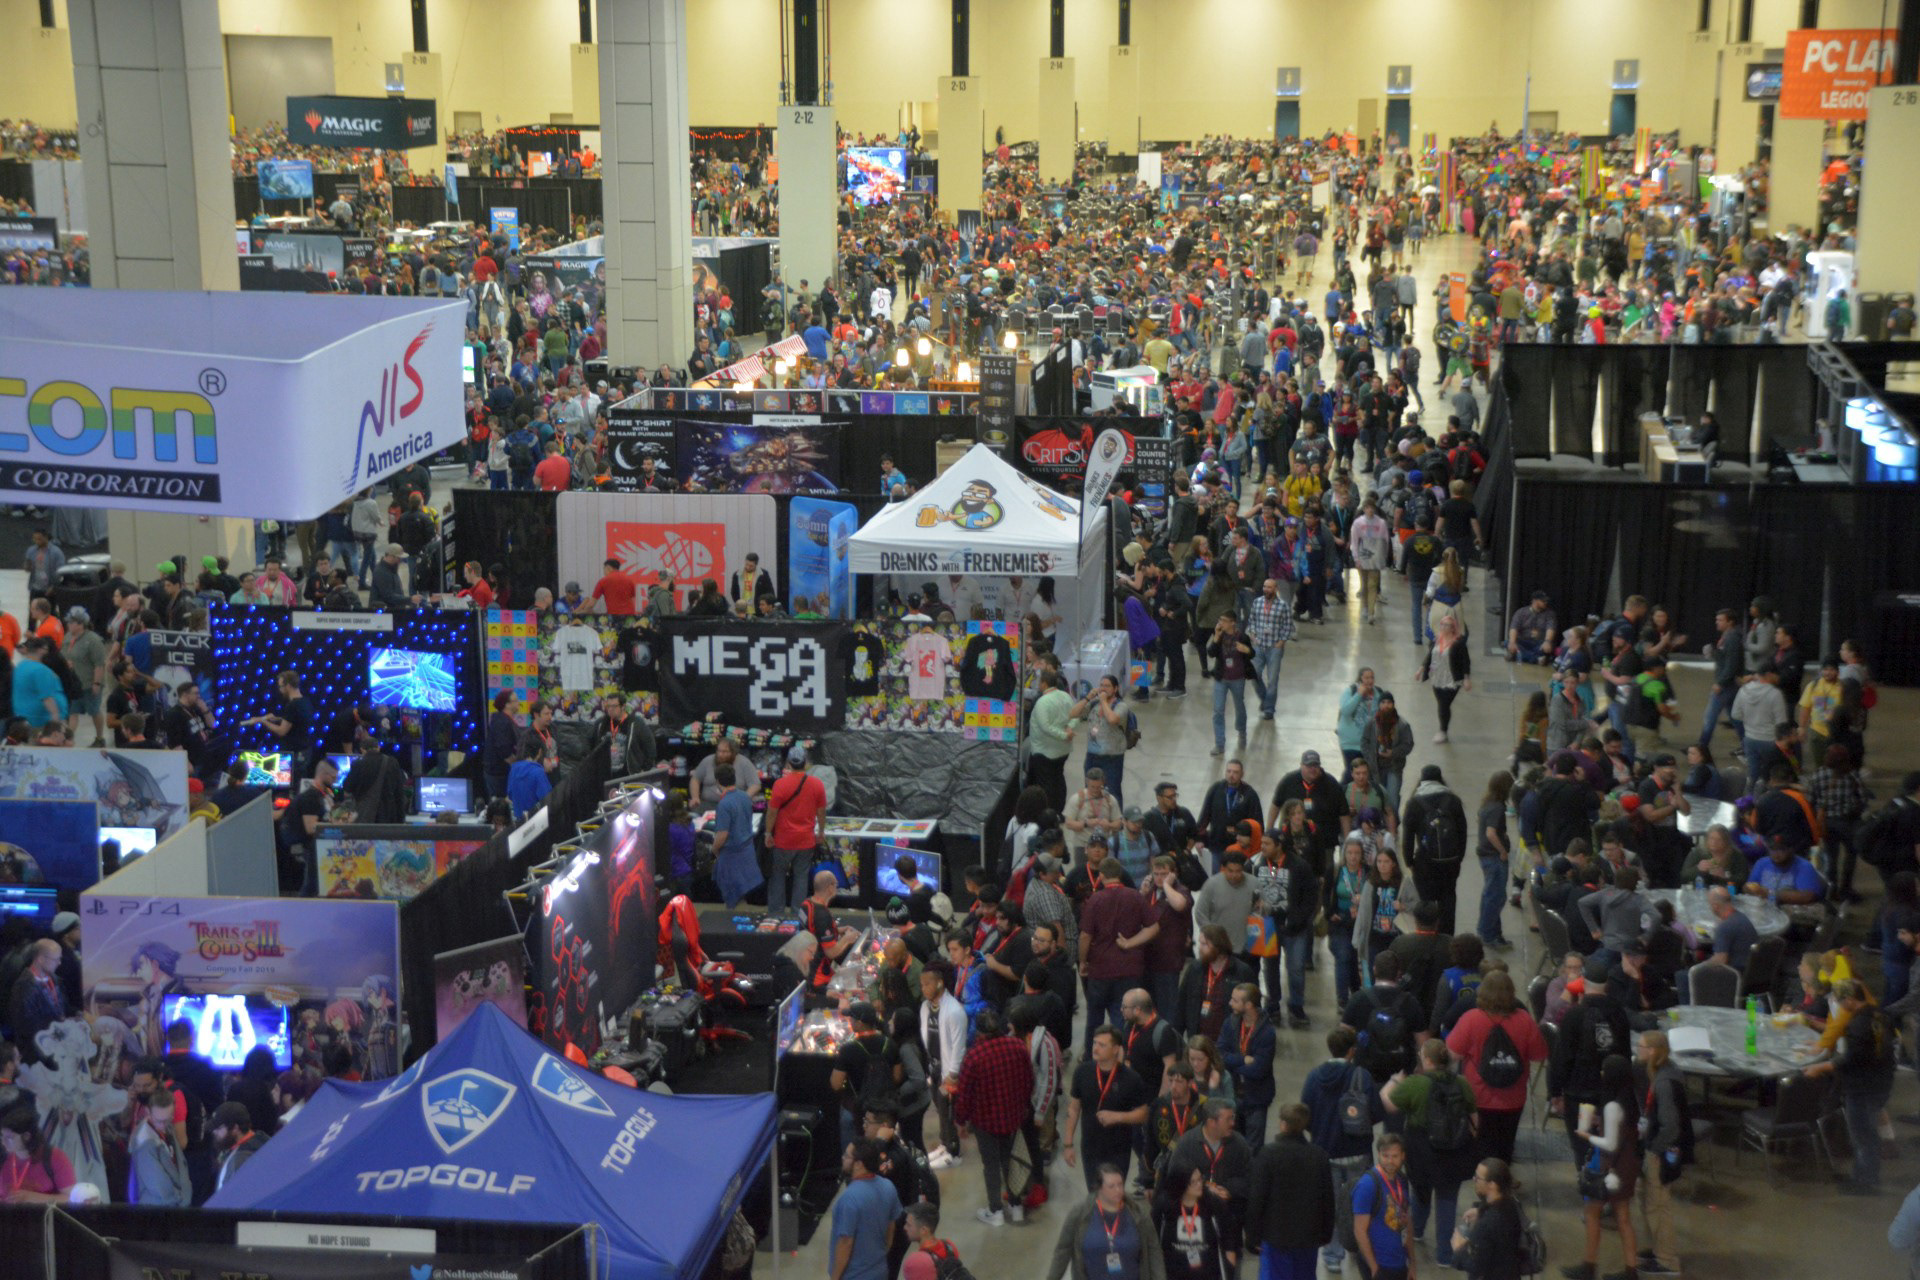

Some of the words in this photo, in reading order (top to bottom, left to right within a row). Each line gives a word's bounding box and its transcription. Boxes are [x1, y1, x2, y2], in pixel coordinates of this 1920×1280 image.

[1802, 38, 1843, 73] PC
[951, 81, 967, 91] 2-13
[1820, 90, 1872, 109] LEGIO
[322, 116, 383, 132] MAGIC
[794, 111, 814, 124] 2-12
[984, 360, 1012, 368] DICE
[608, 419, 633, 427] FREE
[1137, 442, 1167, 450] LIFE
[1137, 450, 1166, 458] COUNTER
[365, 430, 434, 480] America
[13, 468, 205, 497] CORPORATION
[880, 551, 938, 572] DRINKS
[941, 562, 960, 573] WITH
[963, 551, 1050, 573] FRENEMIES
[150, 632, 211, 649] BLACK
[167, 651, 196, 665] ICE
[673, 635, 826, 677] MEGA
[750, 670, 831, 716] 64
[120, 901, 183, 916] PS4
[188, 921, 239, 944] TRAILS
[199, 940, 241, 961] COLD
[602, 1106, 658, 1174] TOPGOLF
[356, 1163, 536, 1195] TOPGOLF
[308, 1234, 318, 1245] NO
[320, 1234, 338, 1246] HOPE
[340, 1236, 371, 1248] STUDIOS
[432, 1267, 519, 1280] @NoHopeStudios
